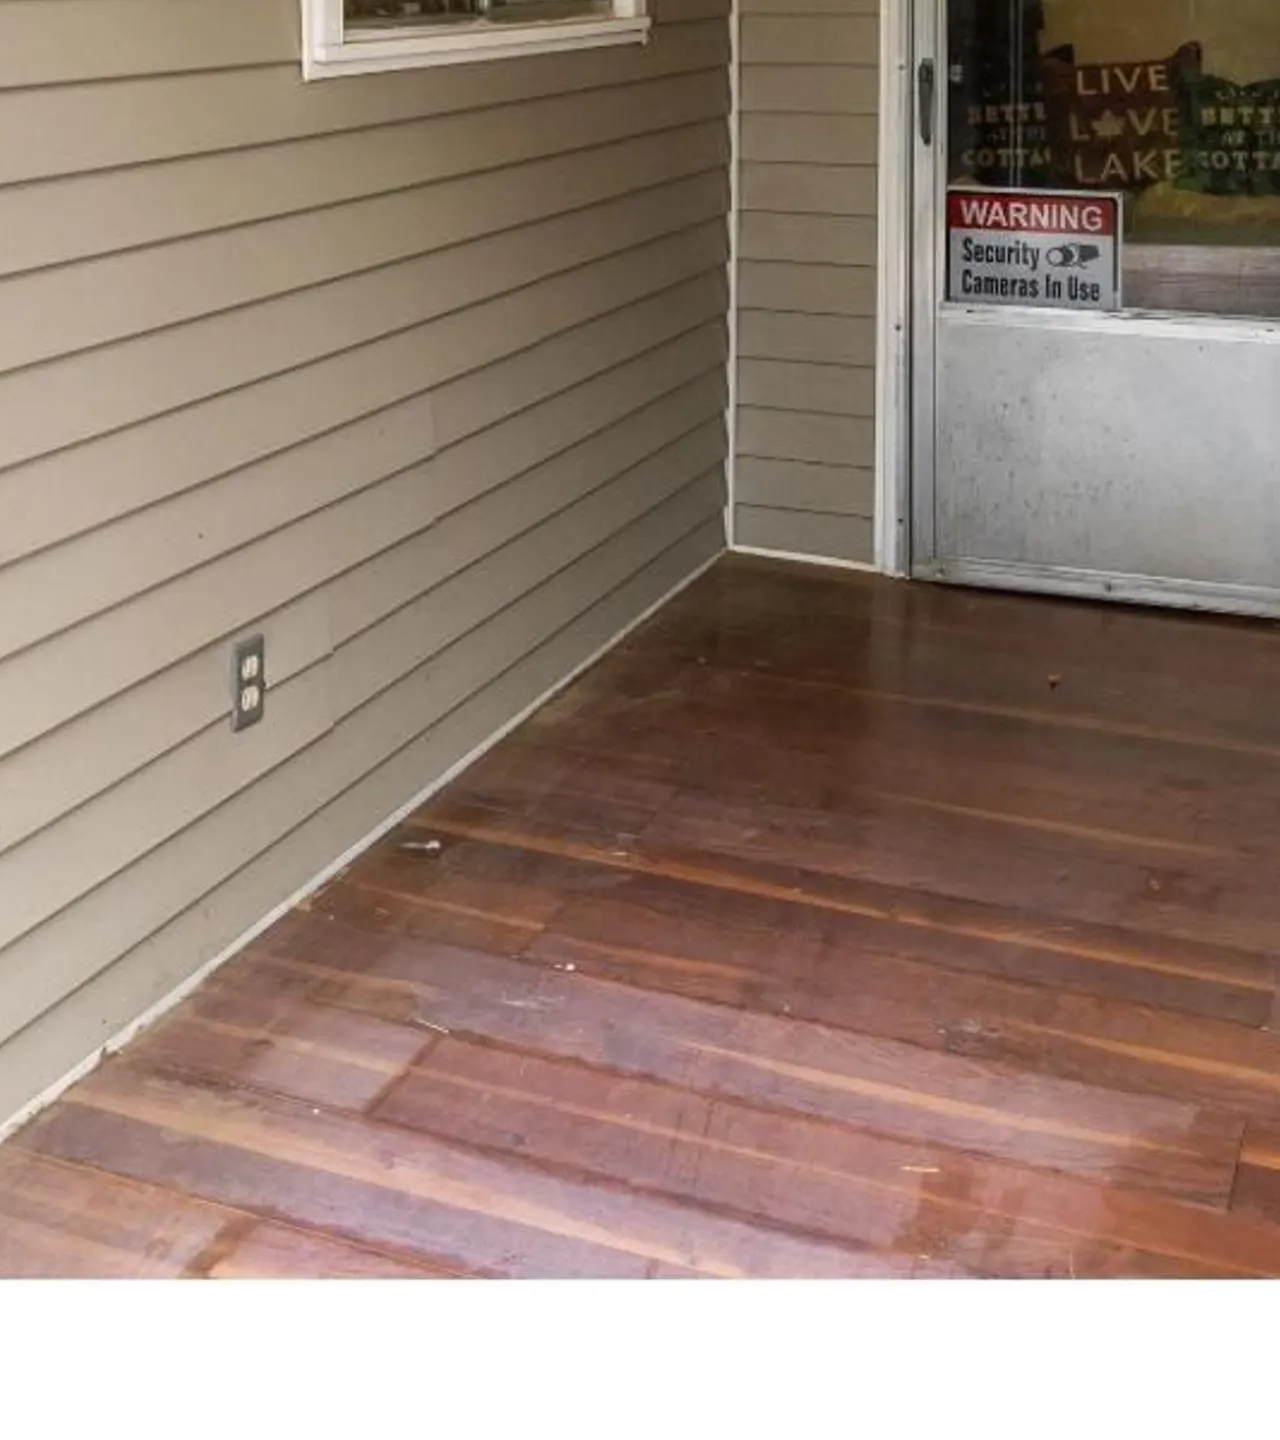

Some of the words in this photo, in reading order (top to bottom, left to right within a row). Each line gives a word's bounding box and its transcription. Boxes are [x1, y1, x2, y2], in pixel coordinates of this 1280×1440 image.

[1076, 64, 1170, 97] LIVE
[1073, 148, 1182, 184] LAKE
[960, 199, 1102, 231] WARNING
[962, 237, 1041, 271] Security
[961, 269, 1040, 298] Cameras
[1045, 274, 1062, 299] In
[1067, 276, 1101, 302] Use
